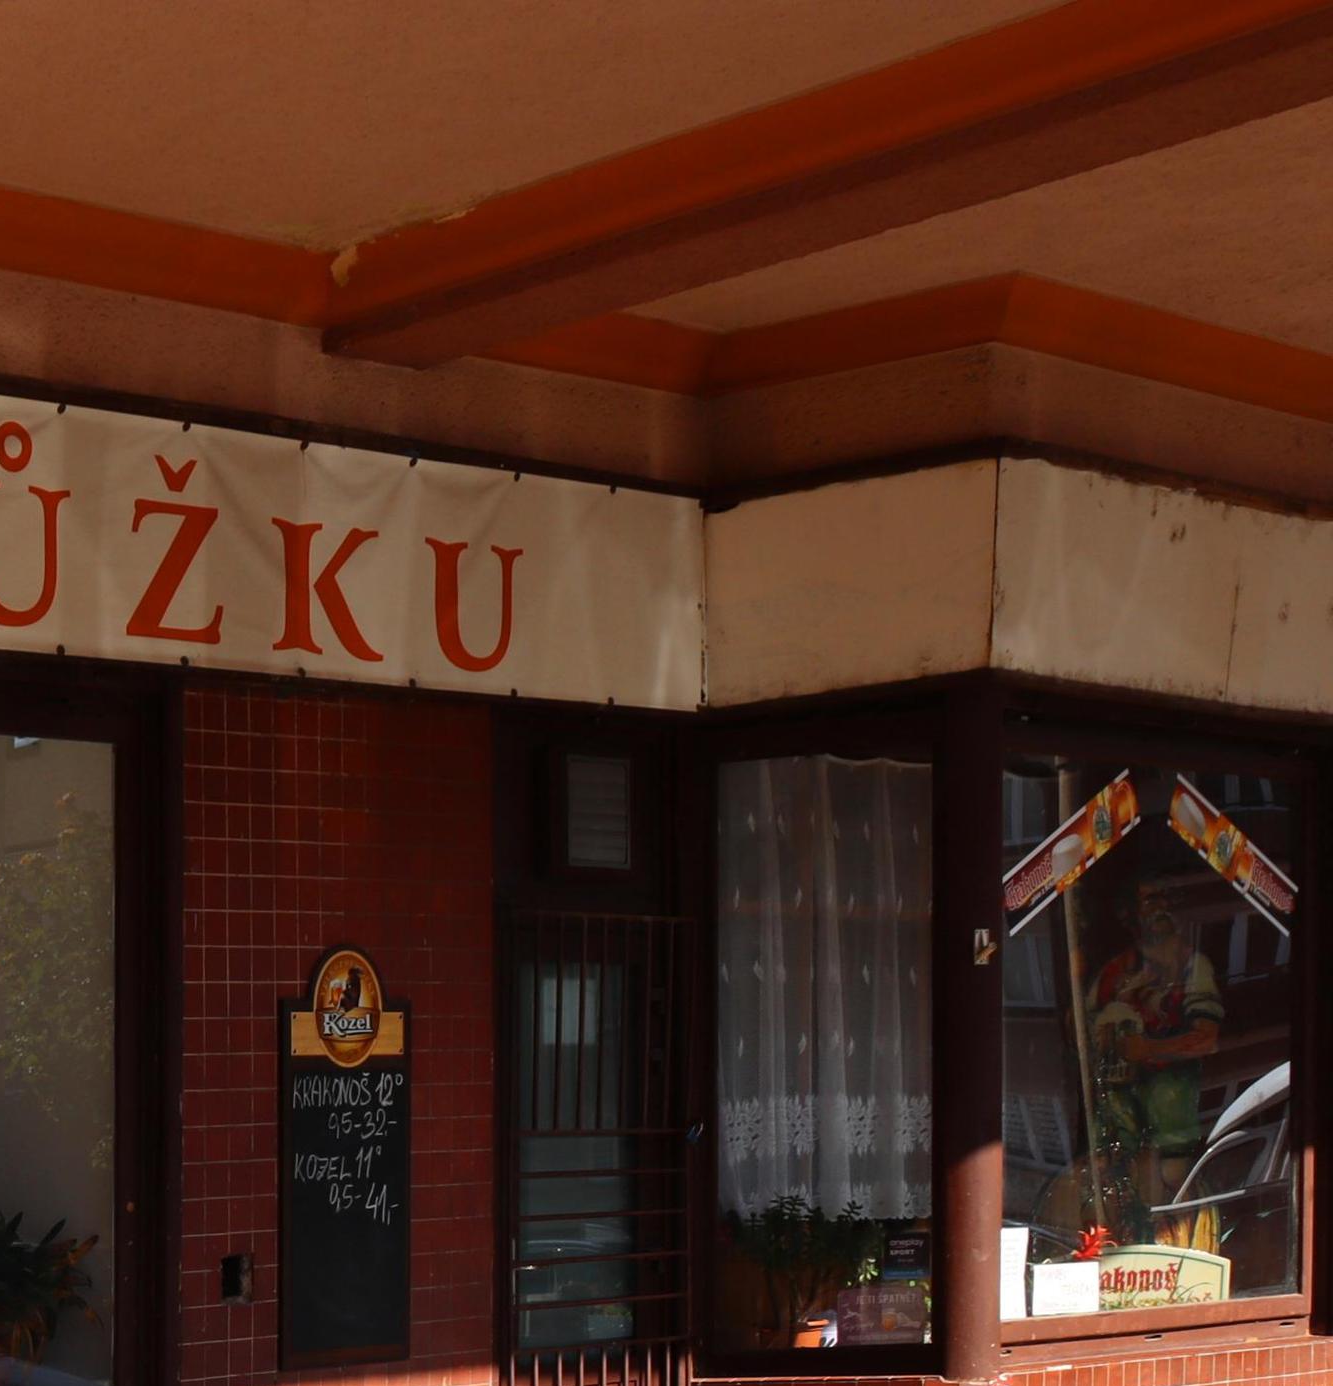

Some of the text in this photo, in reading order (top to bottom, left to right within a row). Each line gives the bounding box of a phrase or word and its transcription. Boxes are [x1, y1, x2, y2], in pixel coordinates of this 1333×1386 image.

[322, 1012, 373, 1036] Kozel
[293, 1072, 371, 1109] KRAKONOŠ
[294, 1153, 352, 1182] KOZEL
[1100, 1262, 1178, 1293] akonoš
